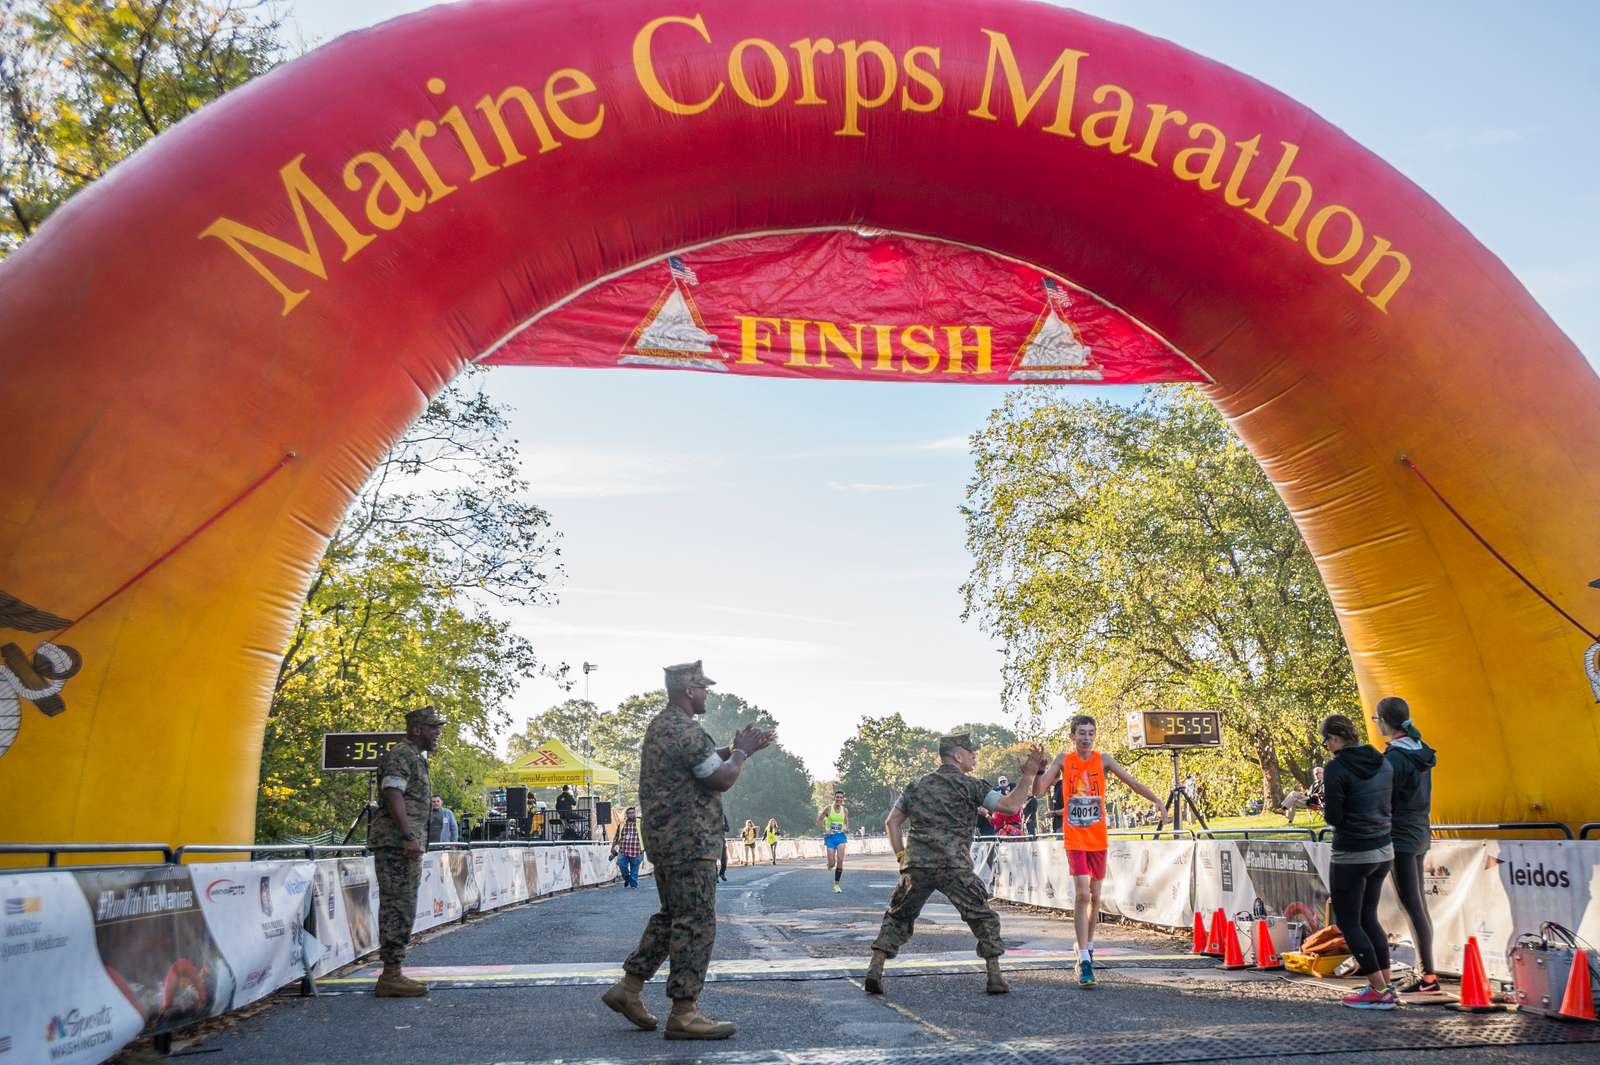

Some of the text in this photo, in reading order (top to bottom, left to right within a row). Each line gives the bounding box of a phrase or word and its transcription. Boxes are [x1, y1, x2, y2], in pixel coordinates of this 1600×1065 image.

[198, 14, 1412, 317] Marine Corps Marathon
[734, 315, 994, 375] FINISH
[1071, 806, 1099, 818] 40012
[1509, 861, 1570, 888] leidos
